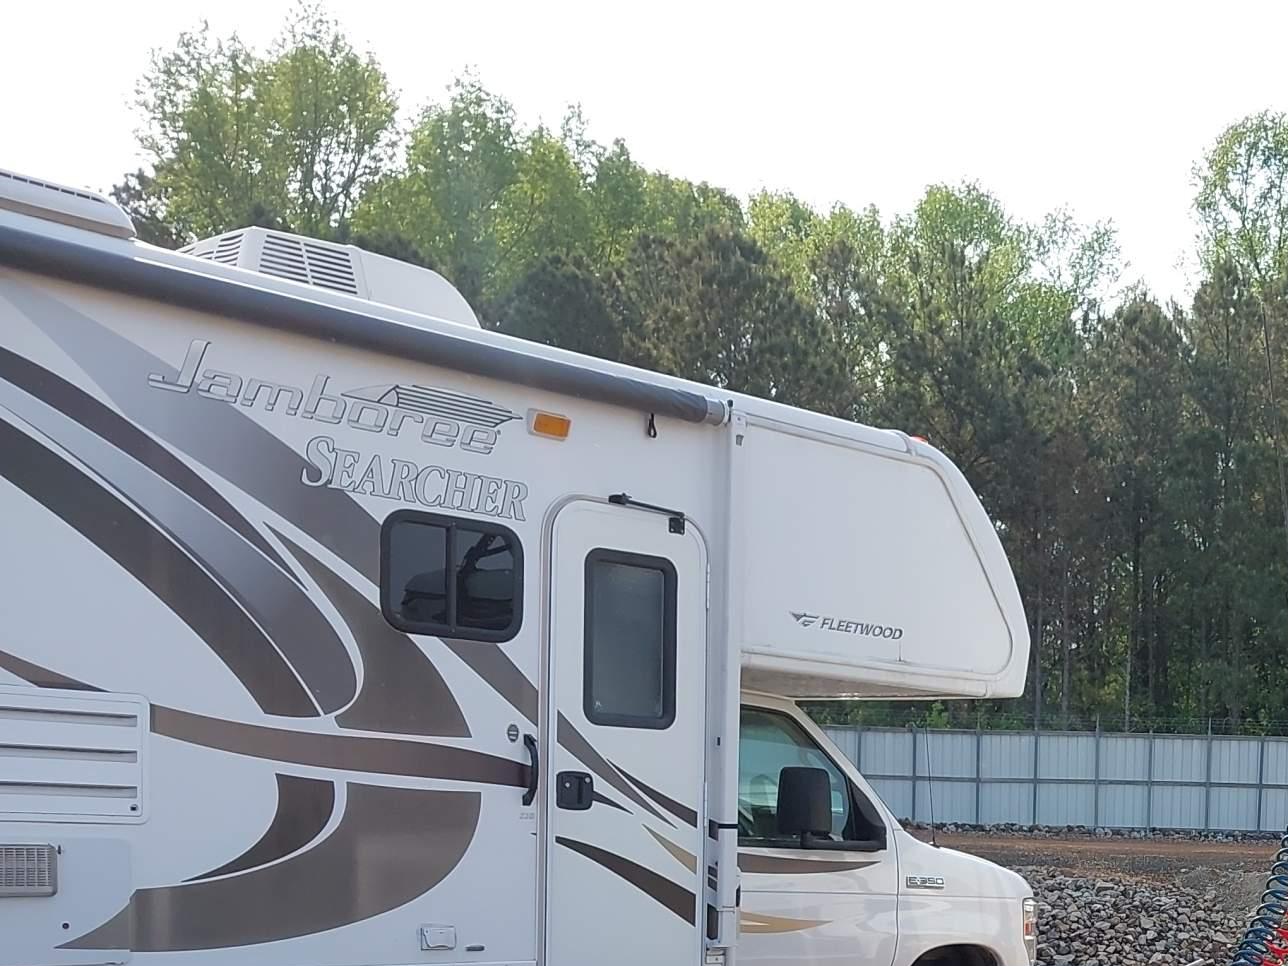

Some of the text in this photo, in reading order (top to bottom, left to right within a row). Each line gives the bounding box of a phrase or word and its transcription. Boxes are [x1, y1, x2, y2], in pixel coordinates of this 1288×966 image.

[147, 339, 497, 455] Jamboree
[300, 435, 529, 522] SEARCHER
[820, 617, 903, 640] FLEETWOOD
[908, 875, 945, 886] E-350
